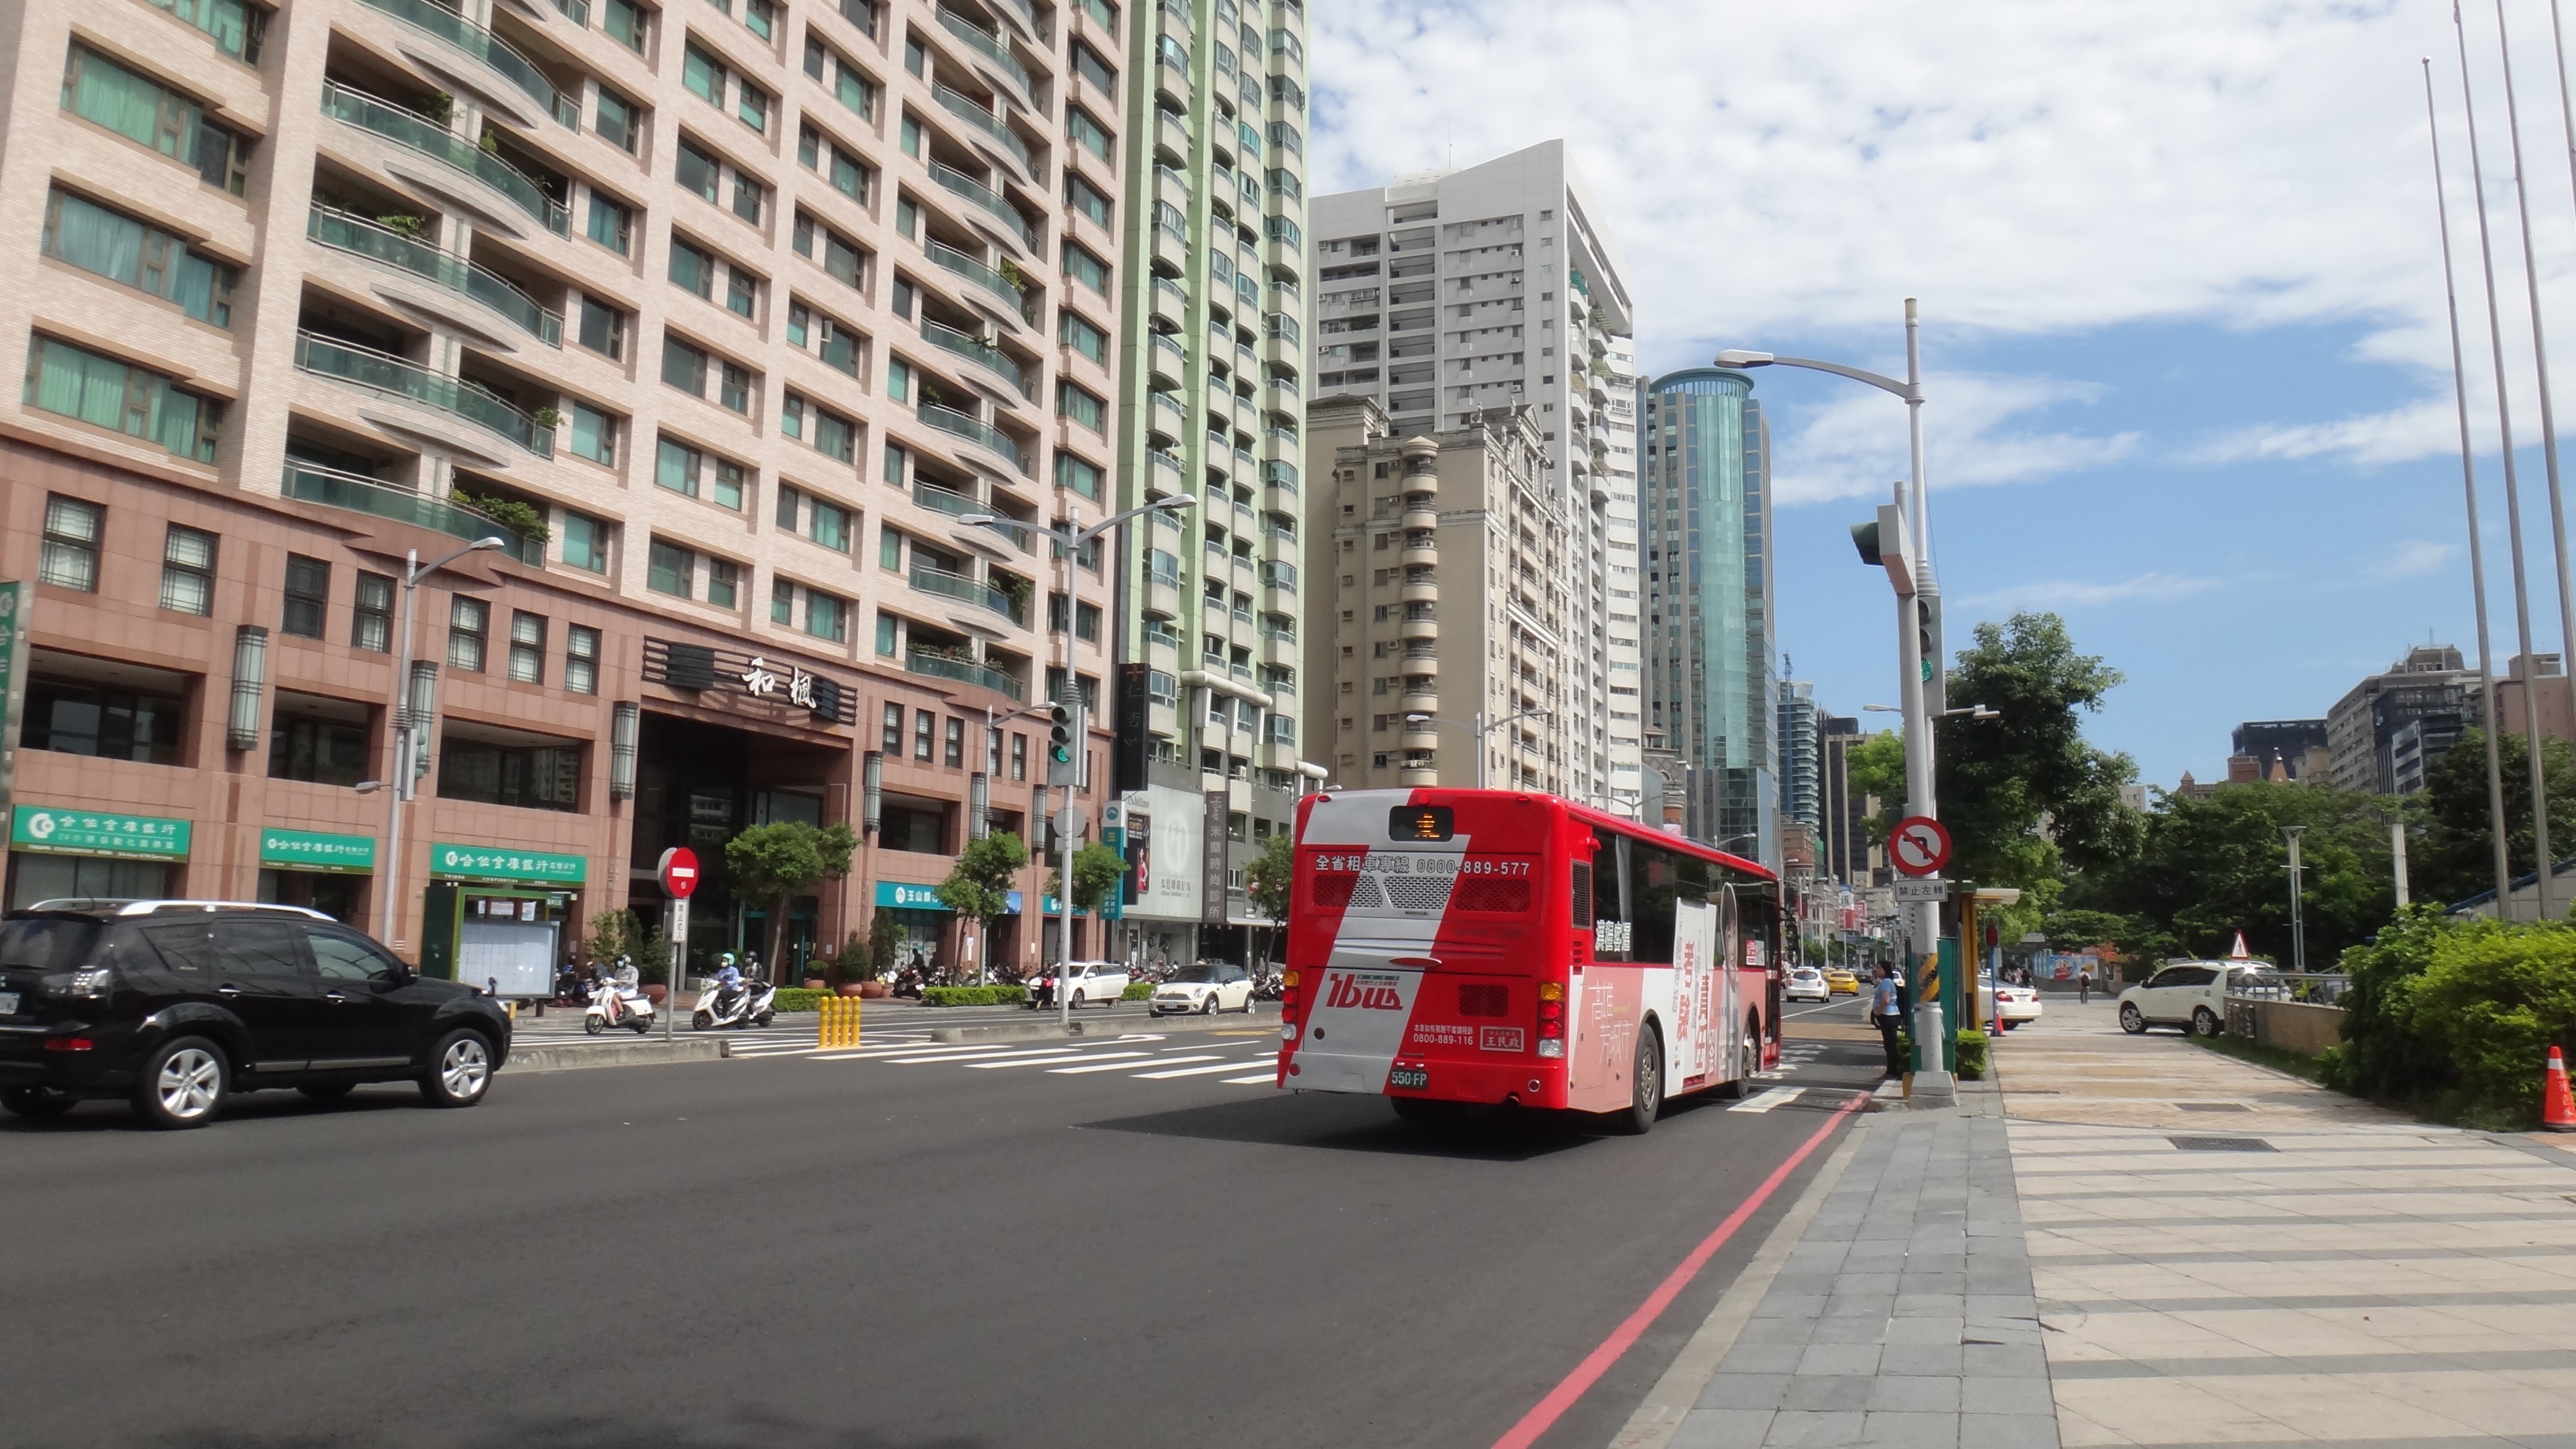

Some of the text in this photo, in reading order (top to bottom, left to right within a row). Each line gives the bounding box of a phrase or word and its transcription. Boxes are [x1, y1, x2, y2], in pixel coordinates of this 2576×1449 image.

[1209, 825, 1221, 918] 米蘭時尚診所
[1315, 855, 1530, 875] 全省租車專線 0800-889-577
[1413, 1034, 1474, 1046] 0800-889-116
[1392, 1071, 1427, 1086] 550-FP
